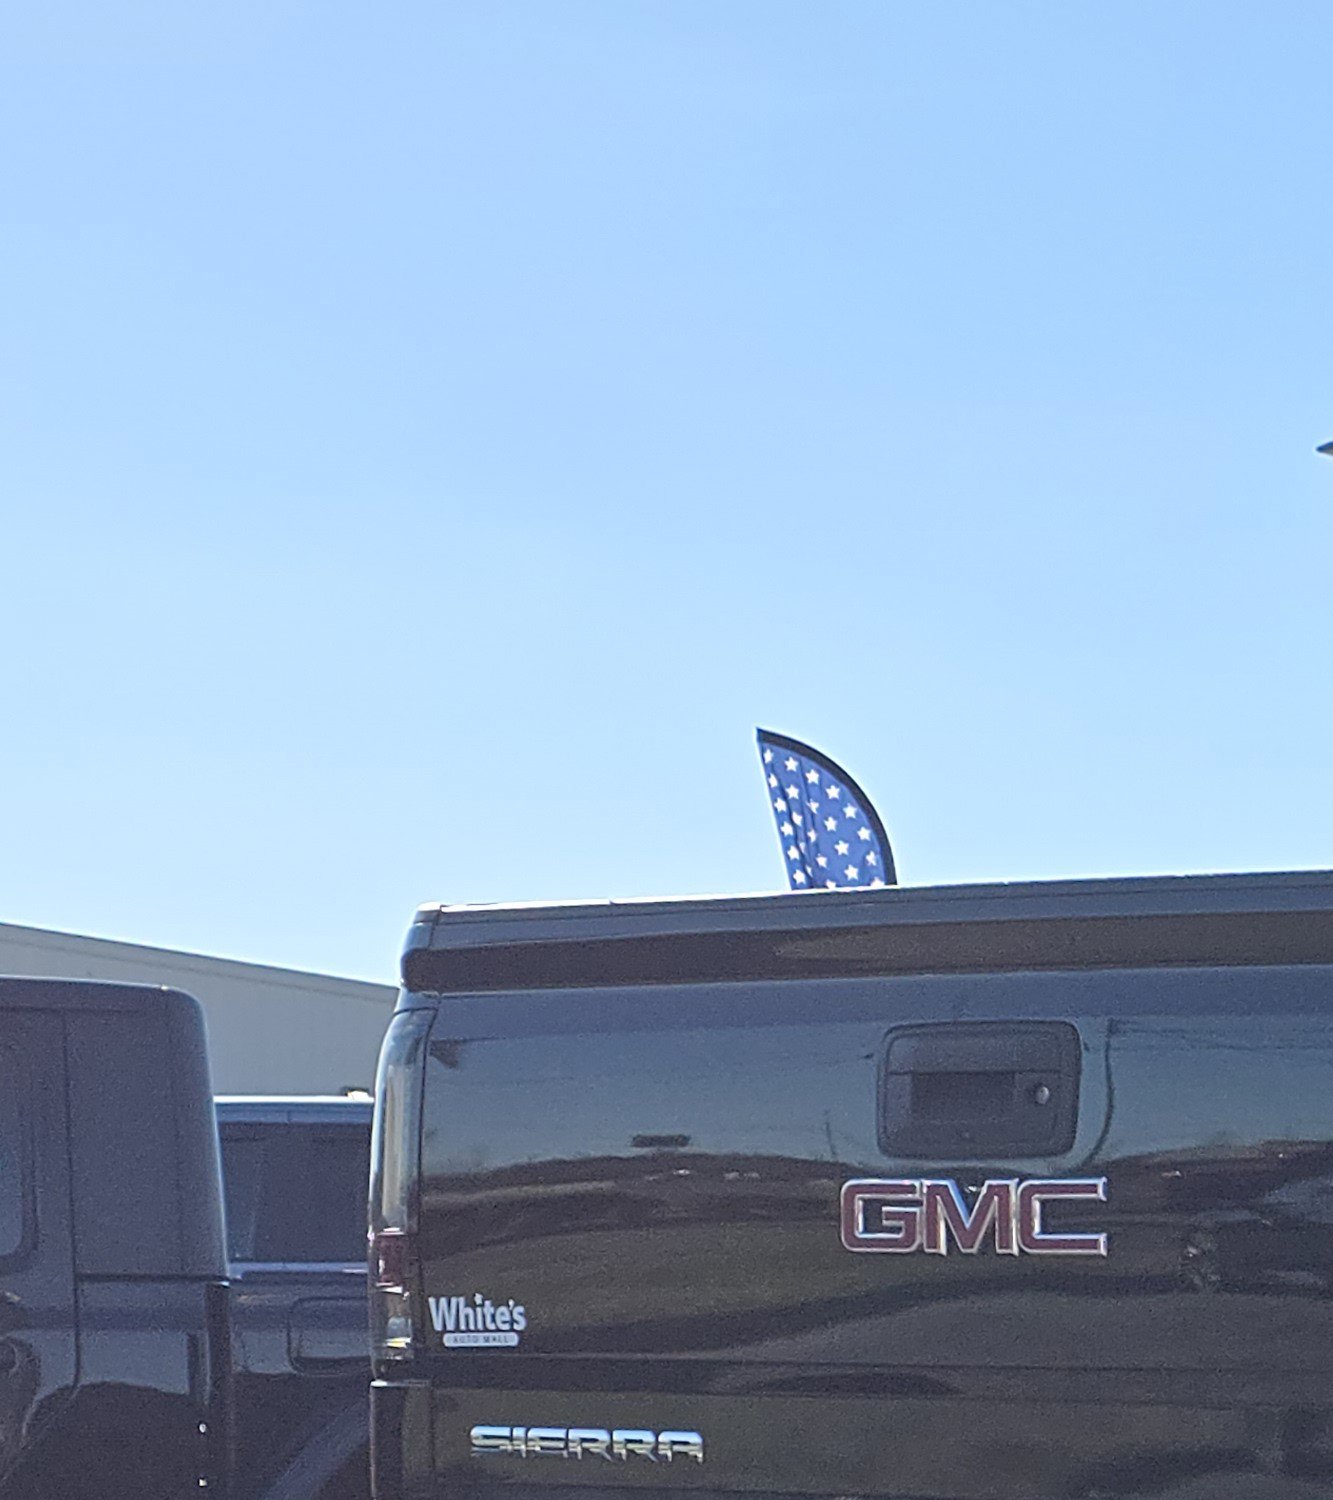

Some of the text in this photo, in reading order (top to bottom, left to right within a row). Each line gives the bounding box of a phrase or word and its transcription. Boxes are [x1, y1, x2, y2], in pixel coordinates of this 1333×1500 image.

[840, 1177, 1108, 1256] GMC
[428, 1292, 527, 1331] White's
[470, 1425, 704, 1464] SIERRA
